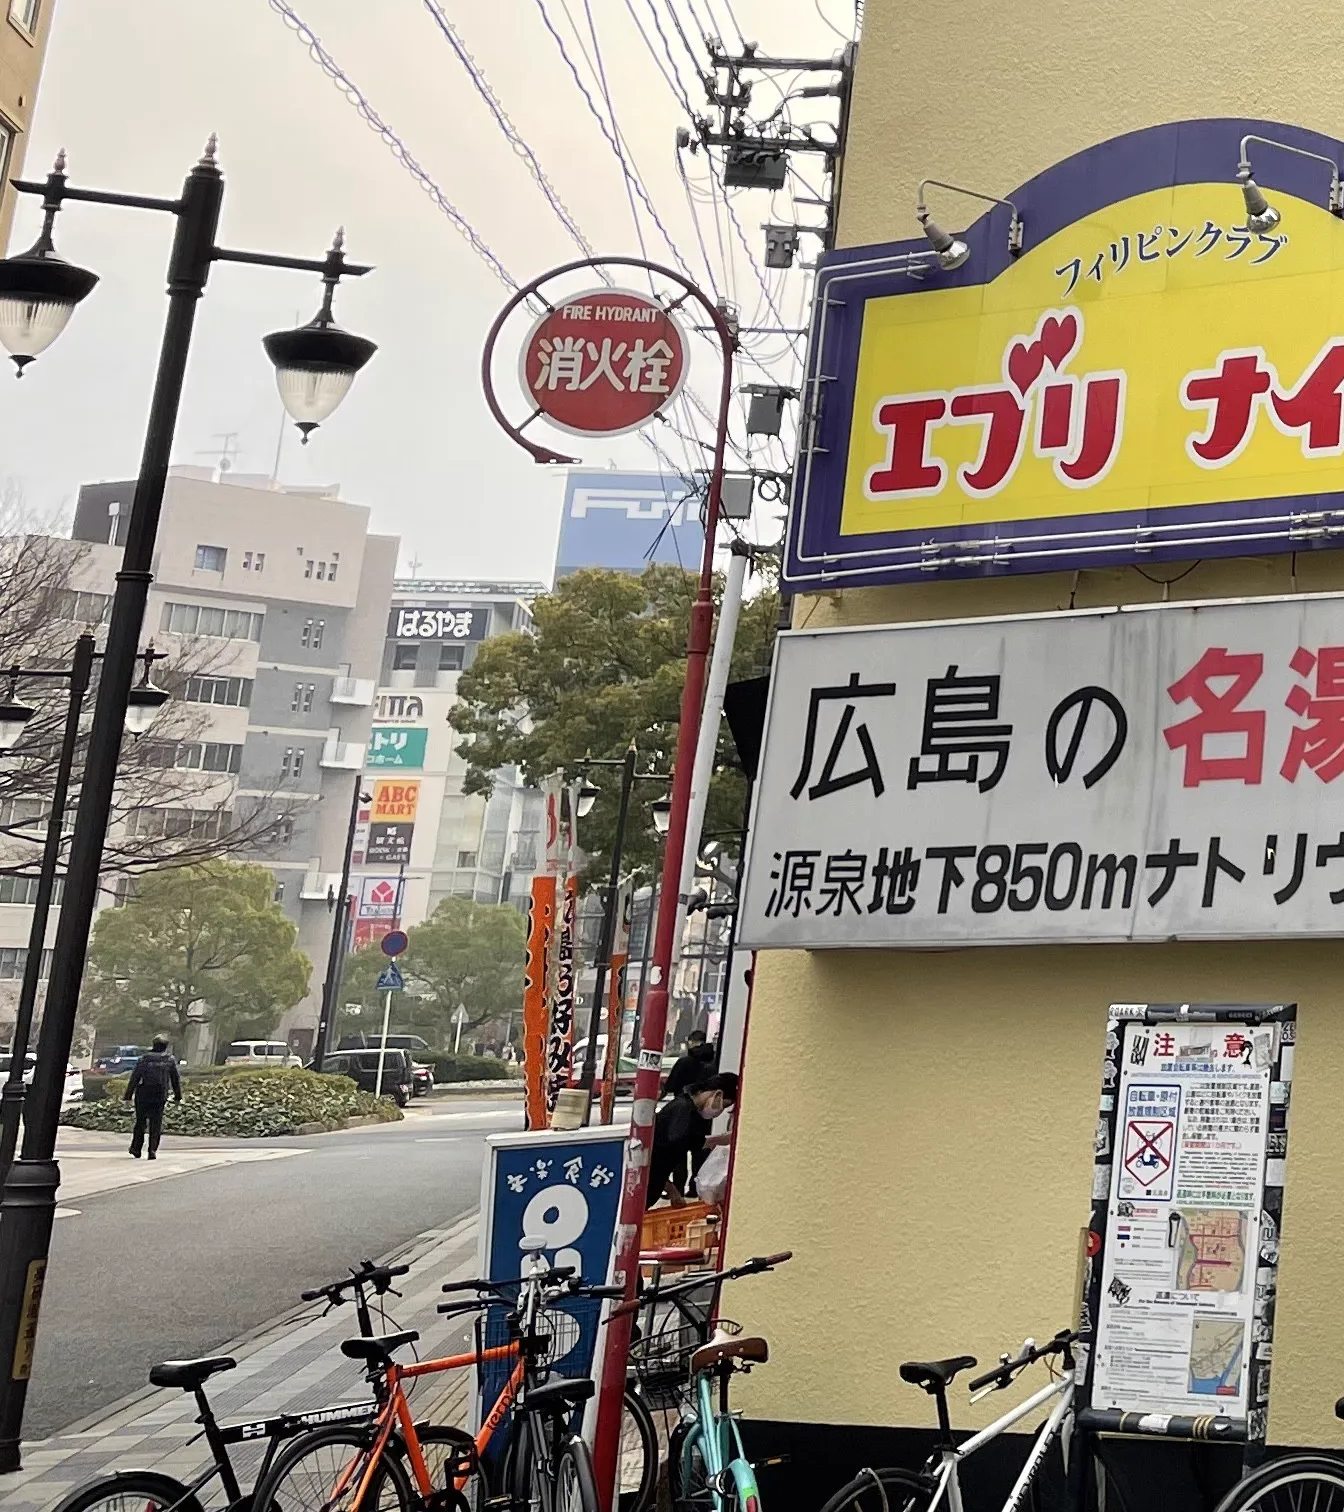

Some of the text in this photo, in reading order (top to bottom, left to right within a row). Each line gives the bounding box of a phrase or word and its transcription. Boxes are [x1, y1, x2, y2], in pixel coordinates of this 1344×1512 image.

[1054, 218, 1290, 300] フィリピンクラブ
[562, 305, 661, 324] FIRE HYDRANT
[534, 336, 675, 394] 消火栓
[865, 310, 1126, 498] エブリ
[396, 609, 473, 638] はるやま
[368, 731, 408, 752] トリ
[378, 785, 418, 803] ABC
[375, 803, 416, 816] MART
